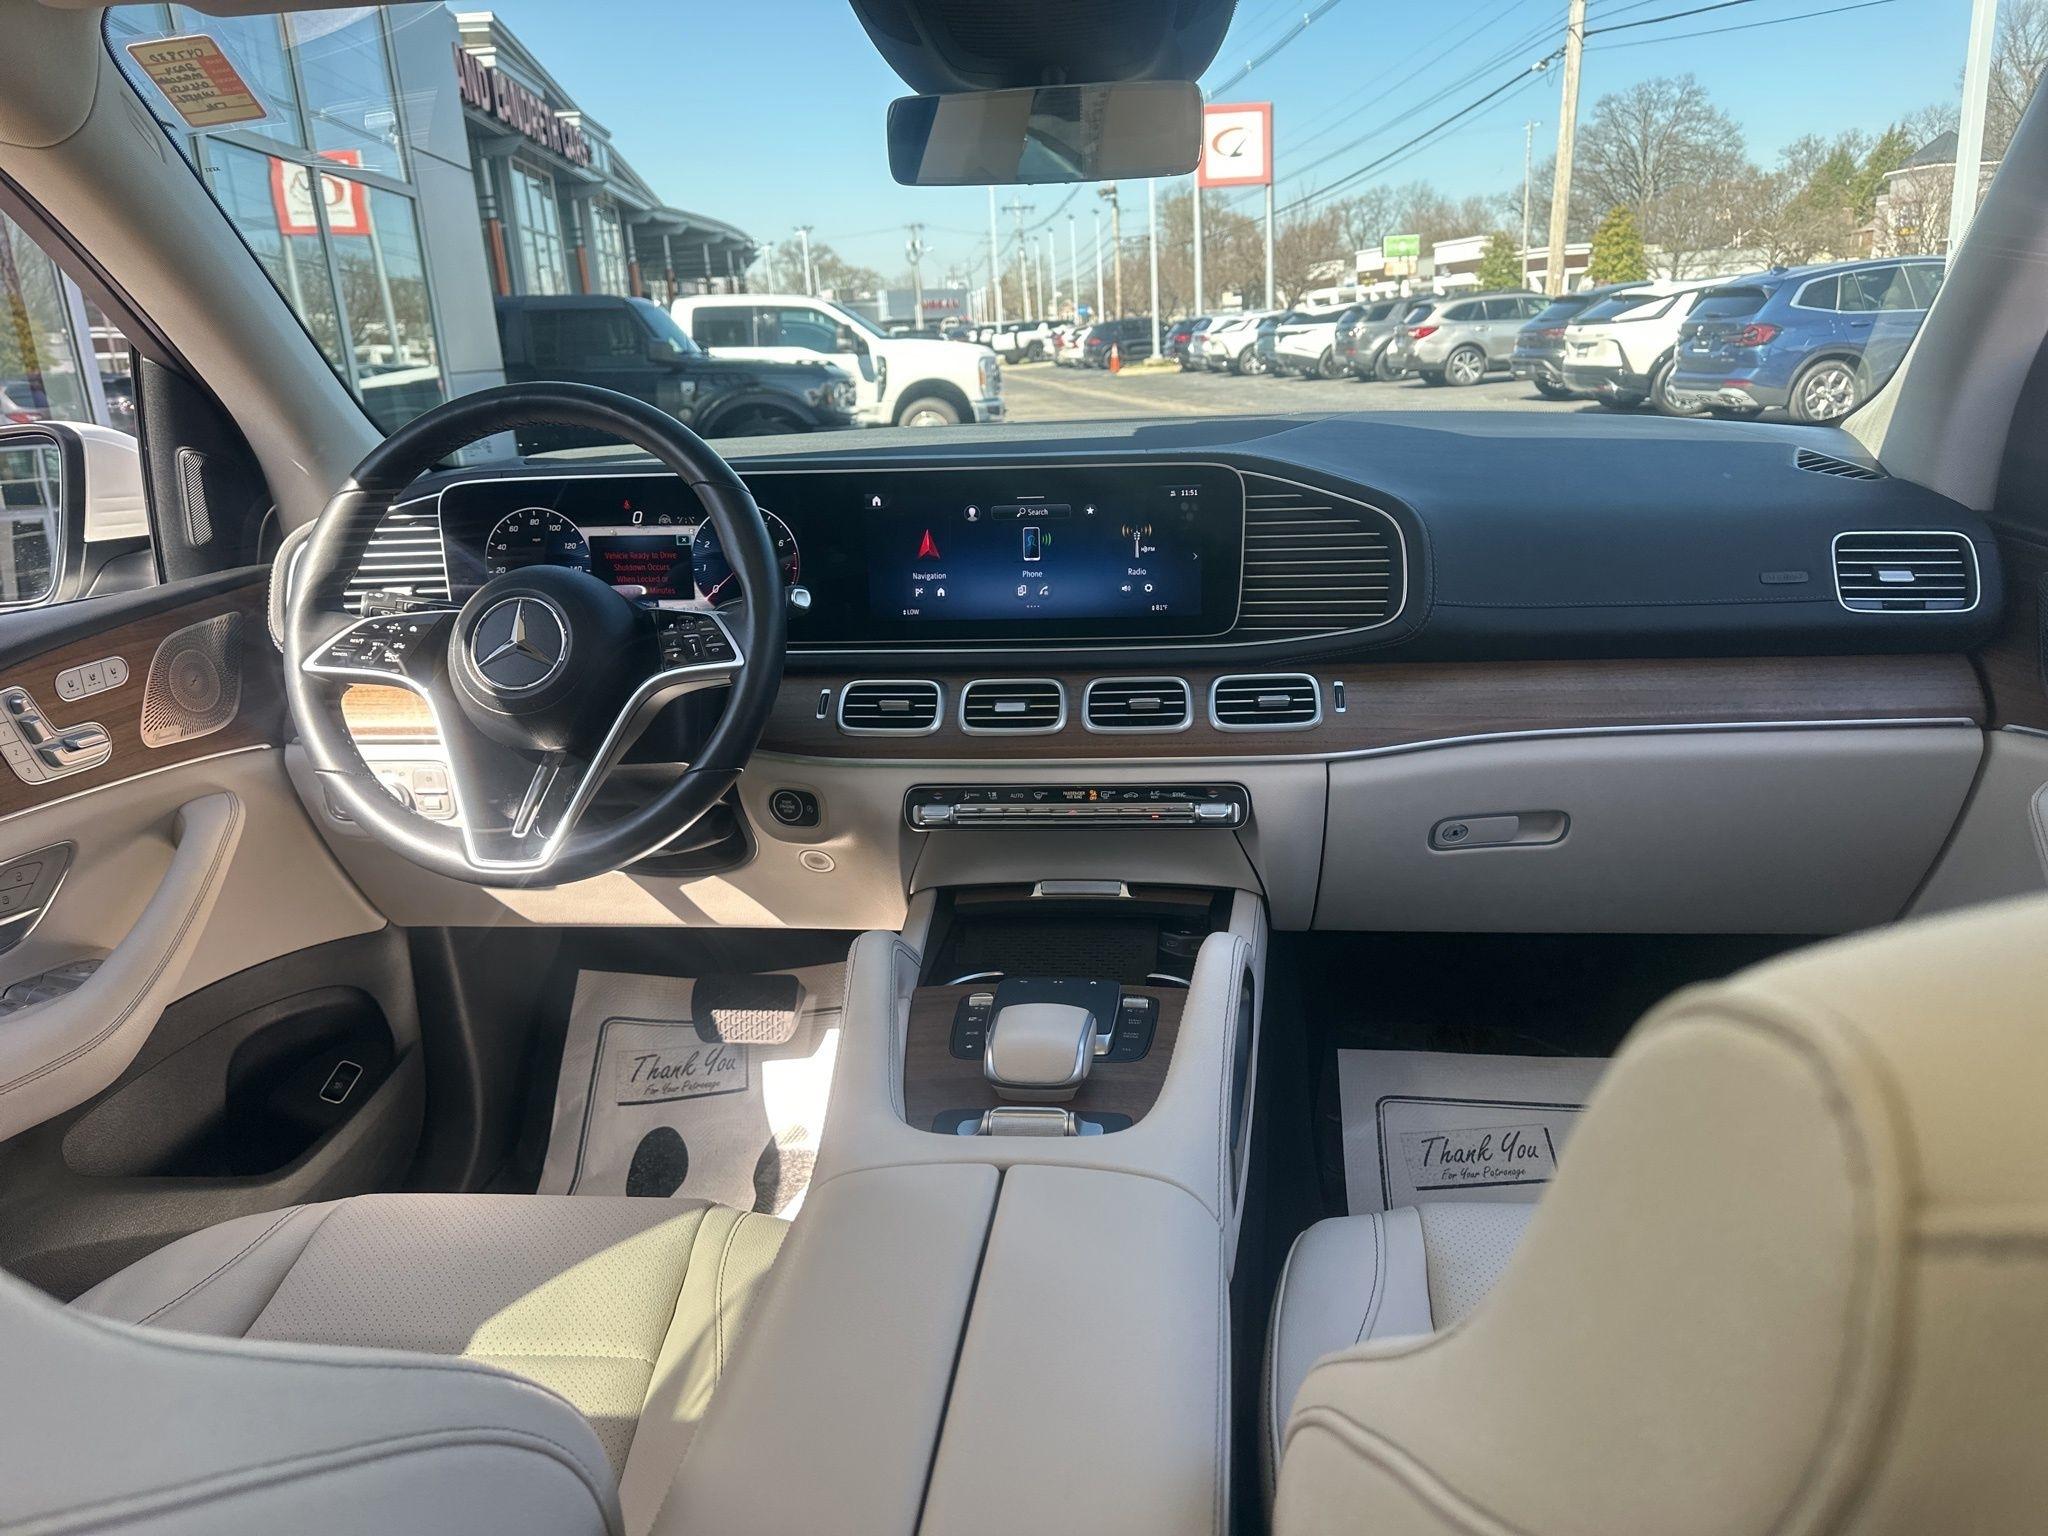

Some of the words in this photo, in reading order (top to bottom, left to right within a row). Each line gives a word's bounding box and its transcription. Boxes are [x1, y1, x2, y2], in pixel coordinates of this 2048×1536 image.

[1028, 508, 1049, 516] Search
[632, 511, 643, 524] 0
[529, 518, 540, 526] 80
[549, 524, 561, 532] 100
[496, 543, 507, 551] 40
[564, 542, 577, 550] 120
[778, 539, 784, 547] 6
[660, 551, 678, 559] Drive
[495, 566, 506, 574] 20
[1022, 570, 1043, 578] Phone
[1127, 567, 1147, 576] Radio
[616, 575, 636, 583] When
[912, 572, 947, 581] Navigation
[712, 584, 719, 593] 0
[907, 608, 920, 616] LOW
[14, 749, 19, 757] 2
[631, 1050, 700, 1083] Thank
[704, 1045, 736, 1076] You
[643, 1083, 659, 1095] For
[662, 1082, 680, 1095] Your
[1421, 1134, 1493, 1167] Thank
[1501, 1131, 1539, 1162] You
[1441, 1168, 1458, 1180] For
[1460, 1167, 1480, 1180] Your
[1483, 1165, 1527, 1180] Patronage
